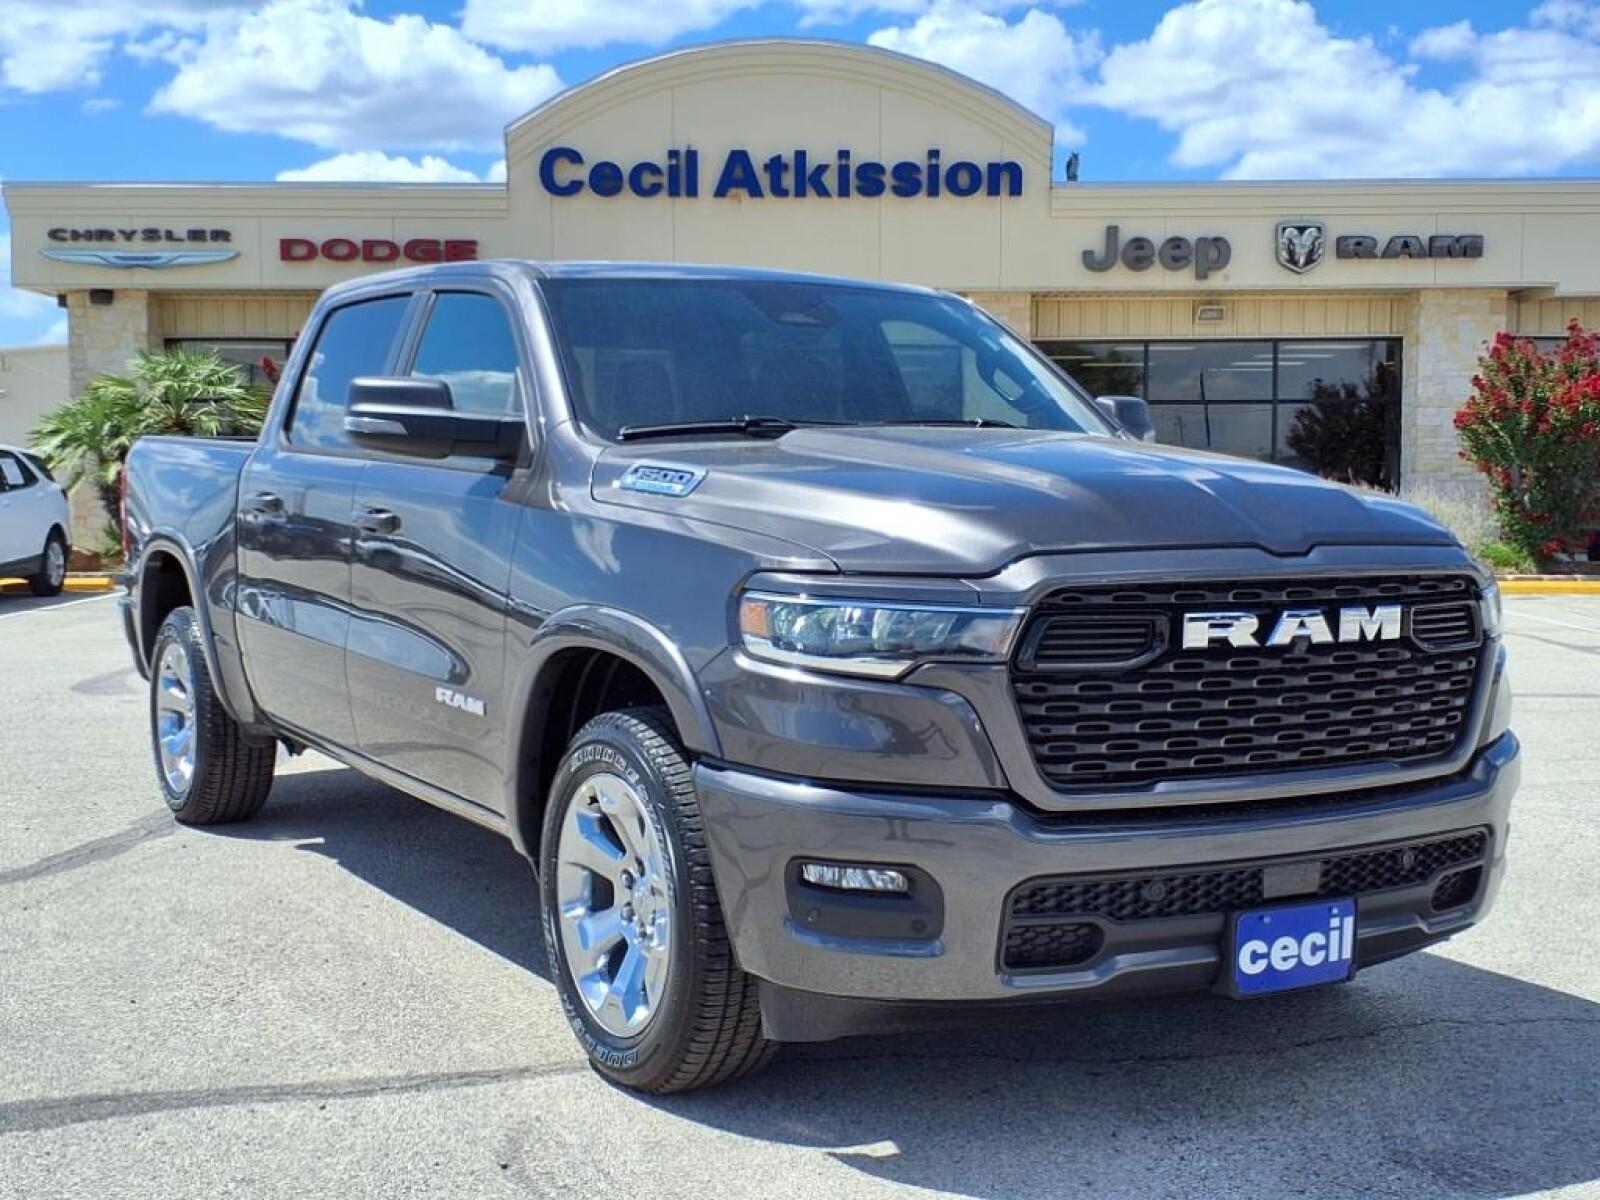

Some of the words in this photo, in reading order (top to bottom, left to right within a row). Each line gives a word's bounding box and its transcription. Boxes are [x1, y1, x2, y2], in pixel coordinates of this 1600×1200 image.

[539, 147, 698, 199] Cecil
[713, 149, 1024, 199] Atkission
[47, 227, 233, 243] CHRYSLER
[279, 238, 479, 262] DODGE
[1082, 225, 1232, 280] Jeep
[1336, 235, 1484, 259] RAM
[1182, 604, 1402, 650] RAM
[435, 687, 484, 716] RAM
[1238, 916, 1354, 975] cecil
